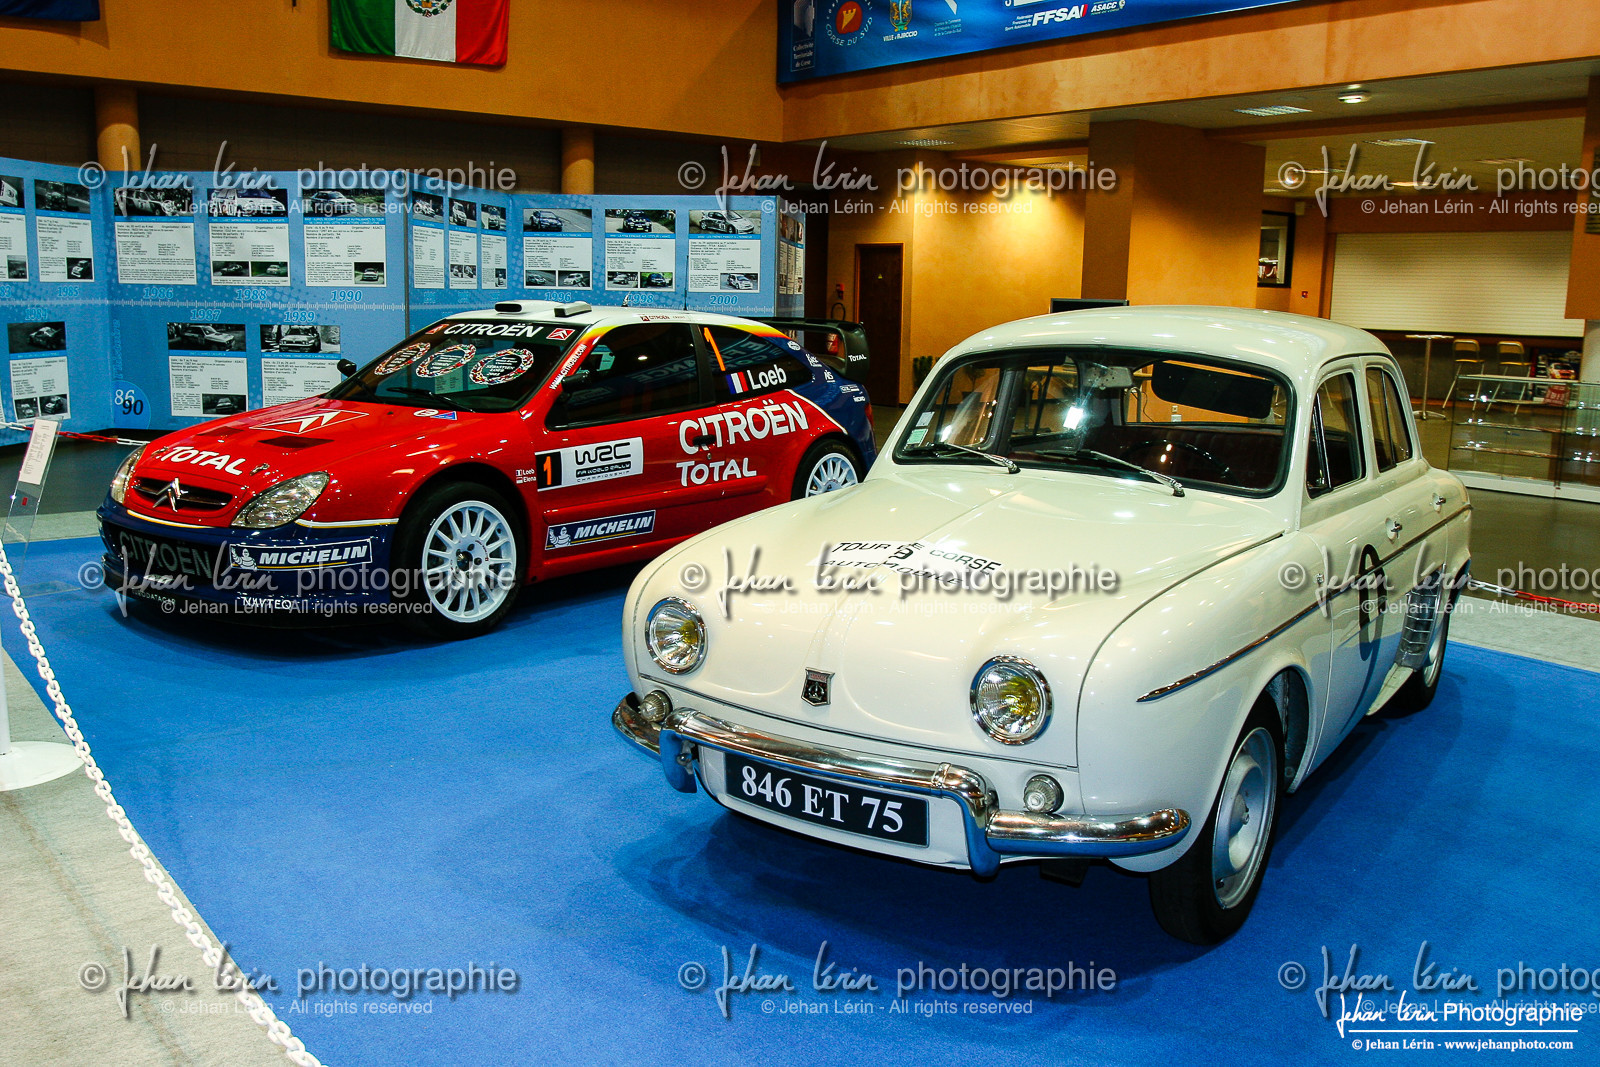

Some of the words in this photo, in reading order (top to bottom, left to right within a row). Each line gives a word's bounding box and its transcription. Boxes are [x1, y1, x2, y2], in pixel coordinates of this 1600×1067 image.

[1091, 2, 1118, 13] ASACC
[1032, 5, 1082, 27] FFSA
[57, 286, 79, 297] 1985
[143, 287, 174, 300] 1986
[236, 288, 267, 301] 1988
[331, 289, 362, 302] 1990
[544, 291, 572, 303] 1996
[625, 292, 654, 304] 1998
[710, 294, 738, 306] 2000
[190, 309, 221, 321] 1987
[284, 310, 315, 322] 1989
[444, 323, 544, 339] CITROËN
[703, 326, 726, 372] 1
[848, 354, 867, 362] TOTAL
[746, 363, 788, 390] Loeb
[114, 389, 136, 406] 86
[121, 399, 144, 416] 90
[679, 399, 810, 456] CITROËN
[160, 446, 246, 476] TOTAL
[575, 442, 632, 466] WRC
[522, 468, 535, 476] Loeb
[543, 456, 552, 486] 1
[577, 470, 630, 483] CHAMPIONSHIP
[587, 466, 609, 474] WORLD
[609, 463, 631, 471] RALLY
[676, 457, 757, 487] TOTAL
[573, 514, 653, 540] MICHELIN
[119, 531, 213, 579] CITROËN
[259, 545, 368, 565] MICHELIN
[832, 542, 891, 553] TOUR
[929, 549, 1002, 576] CORSE
[242, 597, 292, 609] NAVTEQ
[741, 765, 793, 808] 846
[802, 783, 849, 824] ET
[861, 796, 904, 833] 75
